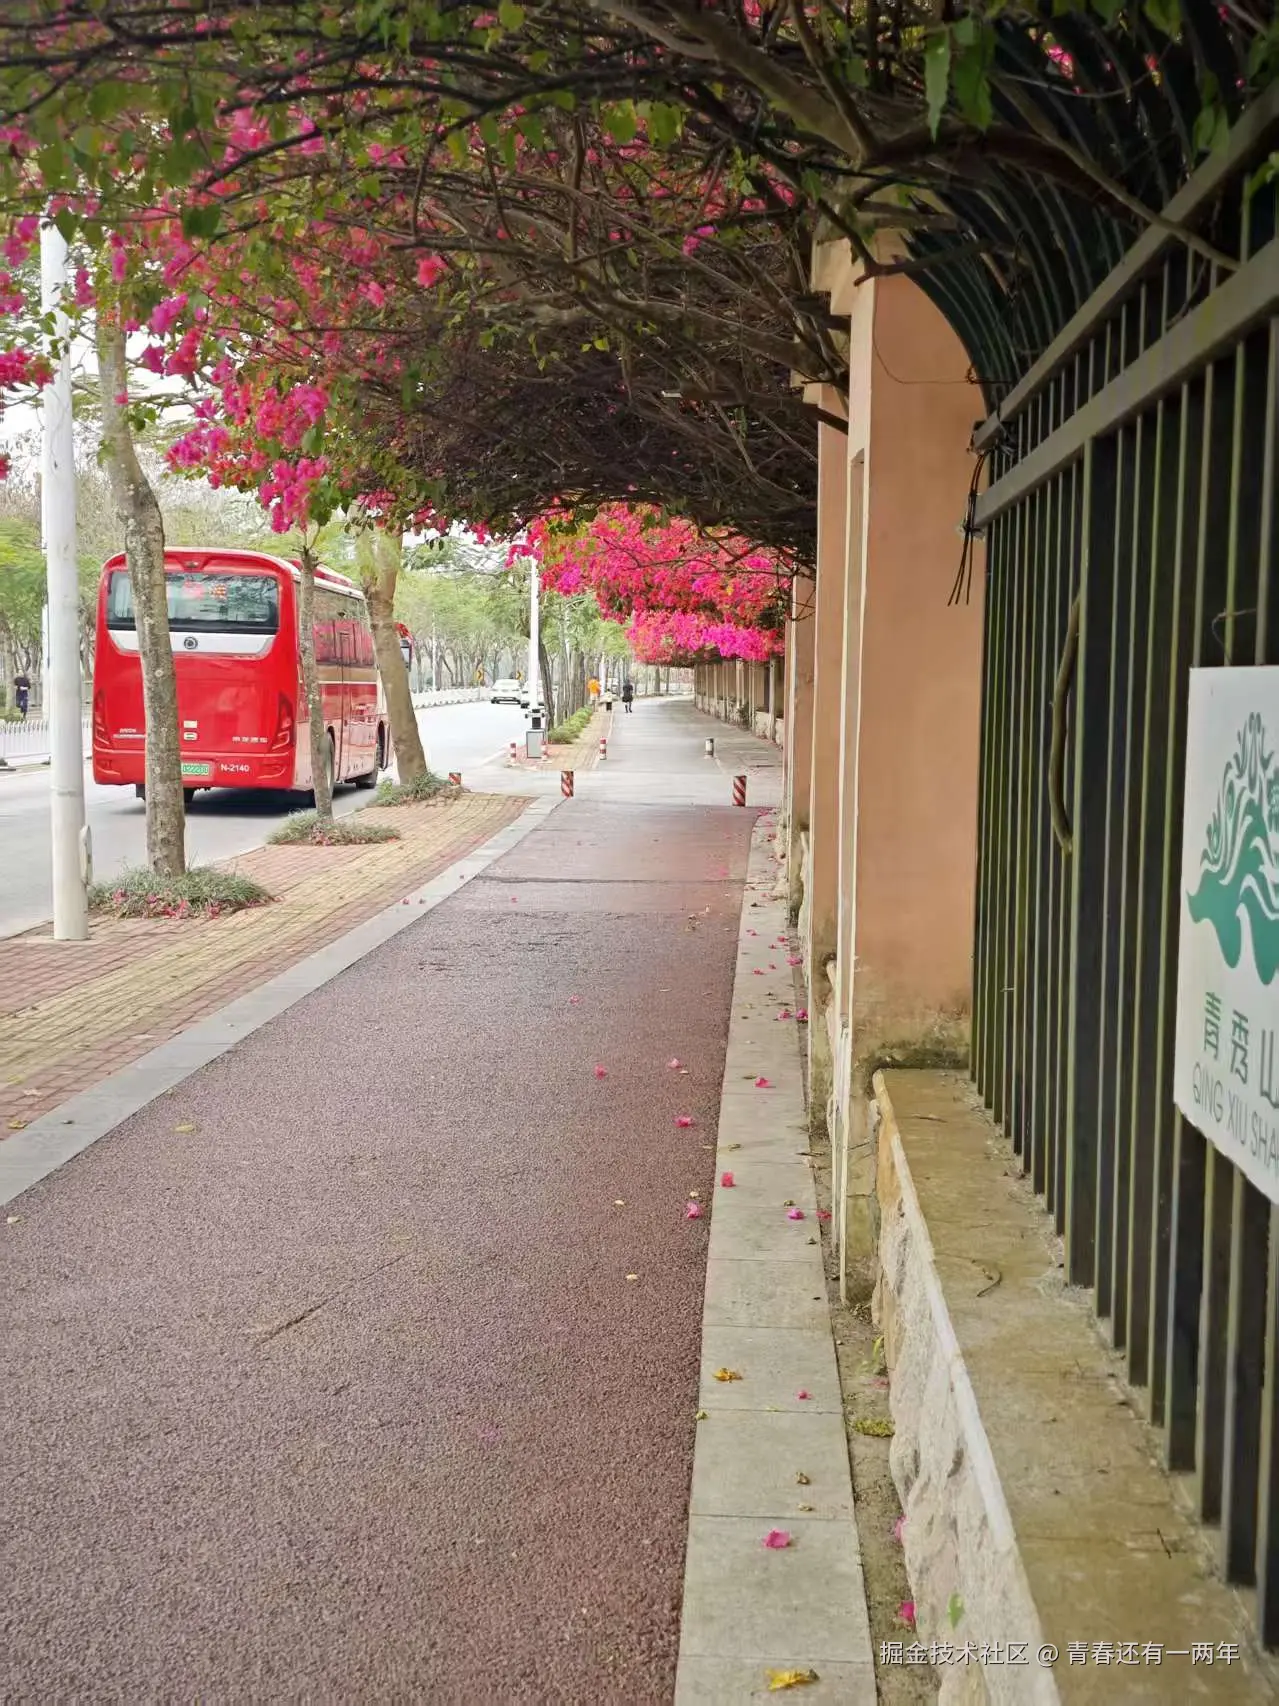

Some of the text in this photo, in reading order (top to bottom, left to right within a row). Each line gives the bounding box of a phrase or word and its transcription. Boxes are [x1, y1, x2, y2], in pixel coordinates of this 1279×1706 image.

[220, 763, 250, 772] N-2140
[1192, 1061, 1224, 1123] QING
[1228, 1089, 1248, 1146] XIU
